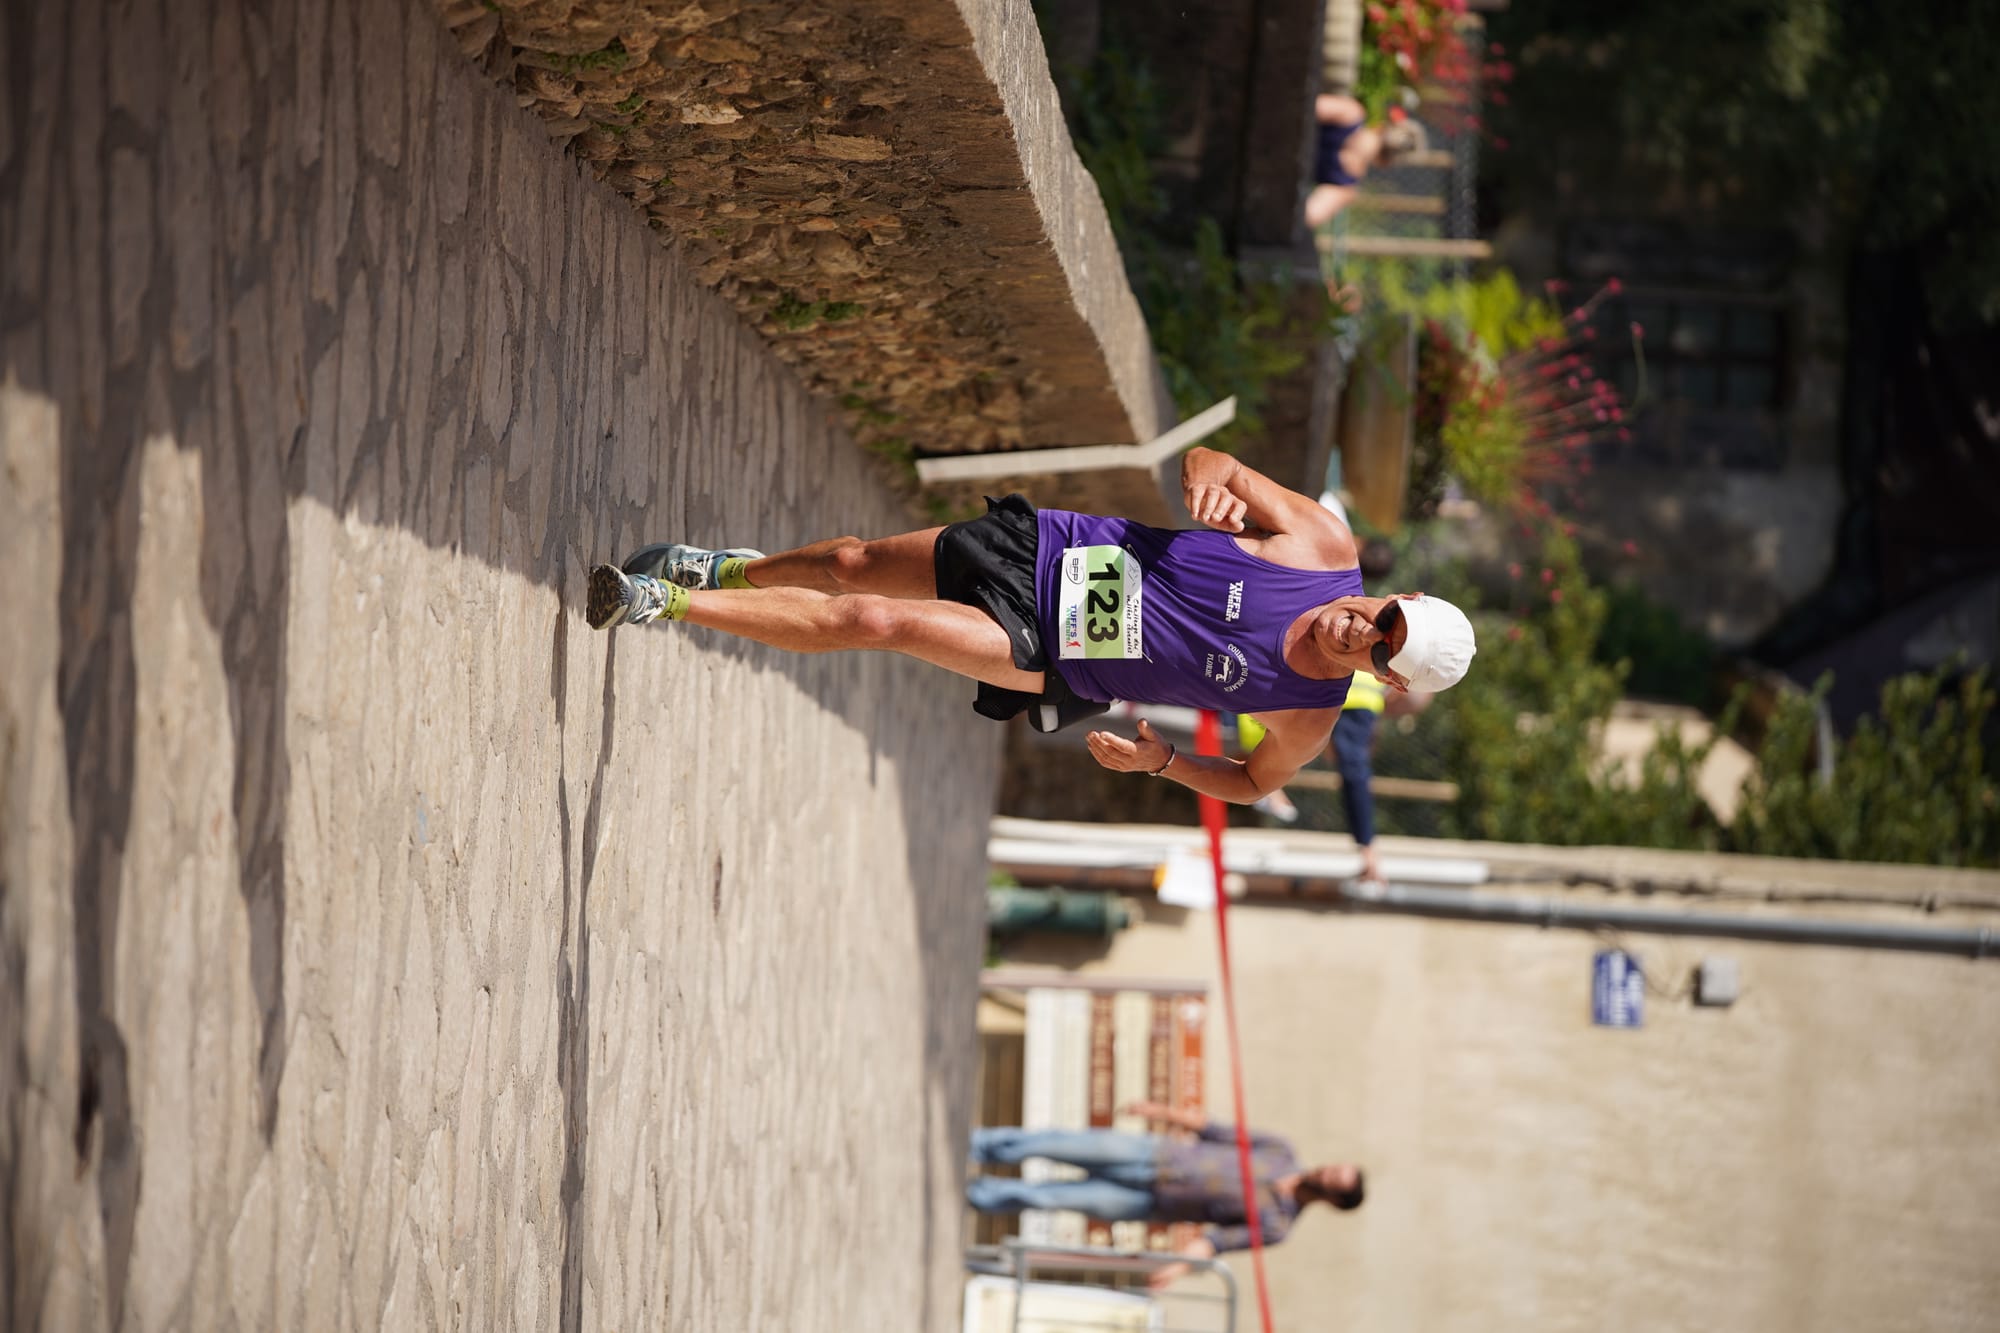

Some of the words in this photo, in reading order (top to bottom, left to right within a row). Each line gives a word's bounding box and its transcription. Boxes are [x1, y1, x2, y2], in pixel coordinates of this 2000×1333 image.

[1087, 563, 1120, 643] 123
[1131, 598, 1139, 634] Challenge
[1231, 580, 1244, 620] TUFF'S
[1070, 604, 1078, 638] TUFF'S
[1227, 643, 1248, 667] COURSE
[1240, 667, 1249, 677] DU
